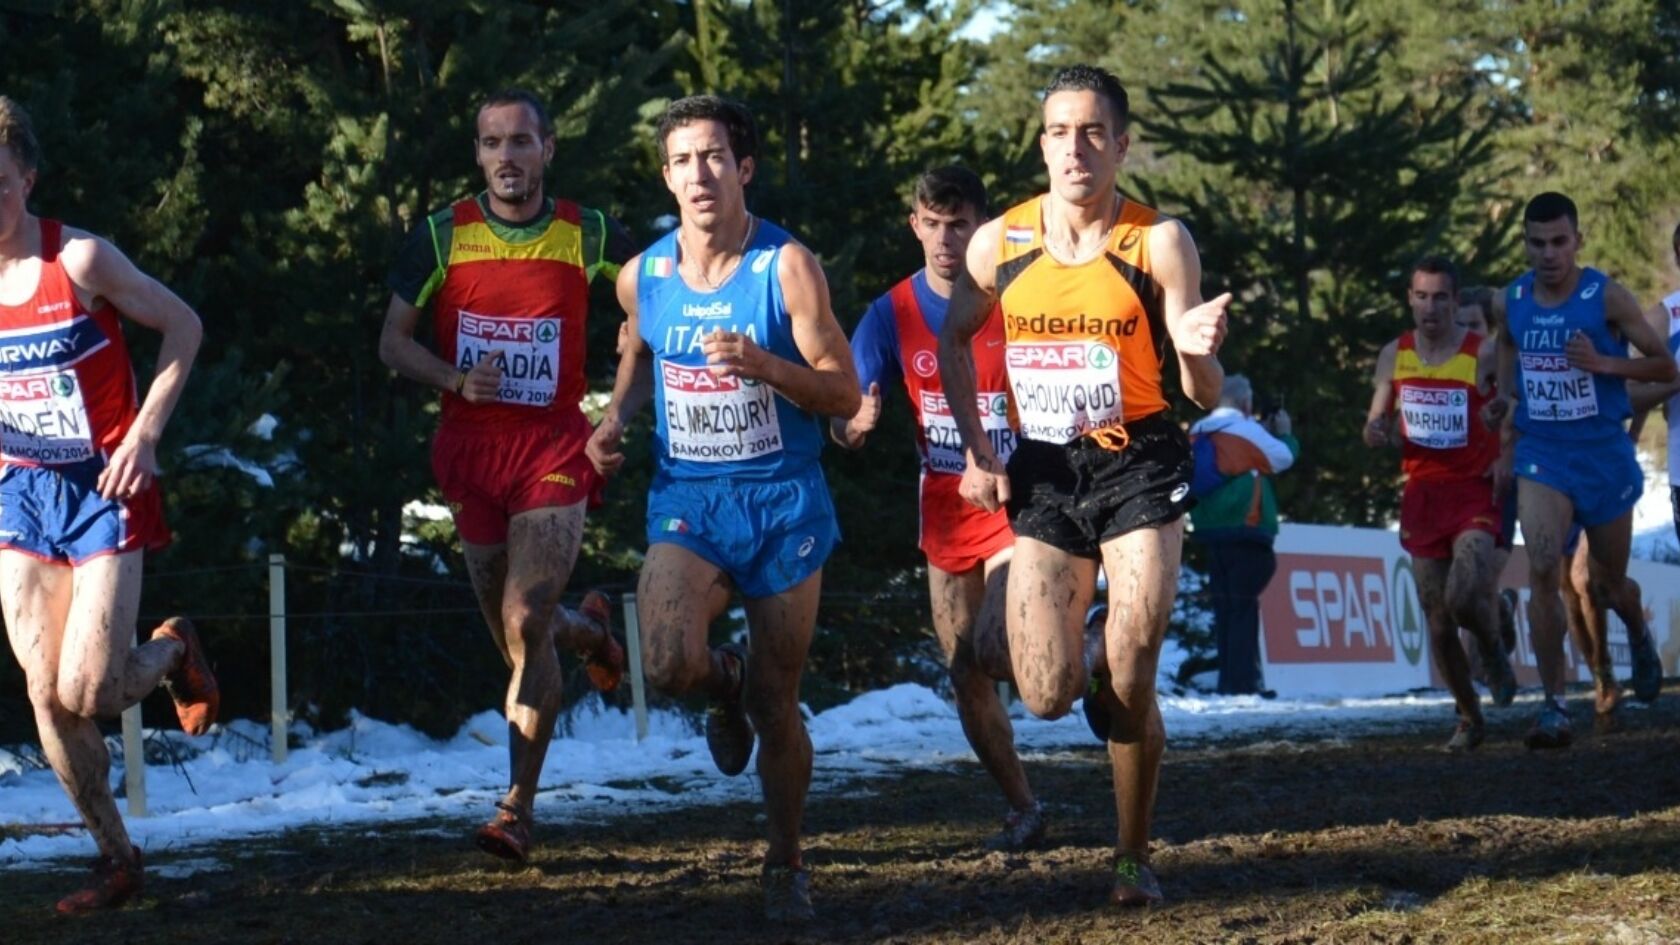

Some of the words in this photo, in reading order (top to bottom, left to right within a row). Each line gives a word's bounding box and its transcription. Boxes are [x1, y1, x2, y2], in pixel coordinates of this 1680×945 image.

[462, 317, 533, 340] SPAR
[1007, 313, 1139, 337] nederland
[0, 333, 80, 364] RWAY
[664, 323, 758, 354] ITAA
[1523, 329, 1571, 350] ITALI
[1008, 345, 1085, 369] SPAR
[1522, 356, 1568, 370] SPAR
[0, 380, 49, 400] PAR
[664, 367, 737, 390] SPAR
[1526, 377, 1592, 401] RAZINE
[922, 396, 990, 415] SPR
[1016, 381, 1117, 414] CHOUKOUD
[1403, 389, 1449, 405] SPAR
[667, 400, 686, 432] EL
[687, 395, 771, 434] MAZOURY
[1405, 409, 1465, 432] MARHUM
[64, 448, 91, 458] 2014
[672, 442, 745, 457] SAMOKOV
[749, 435, 779, 454] 2014
[931, 456, 963, 471] SAMO
[1289, 569, 1393, 648] SPAR
